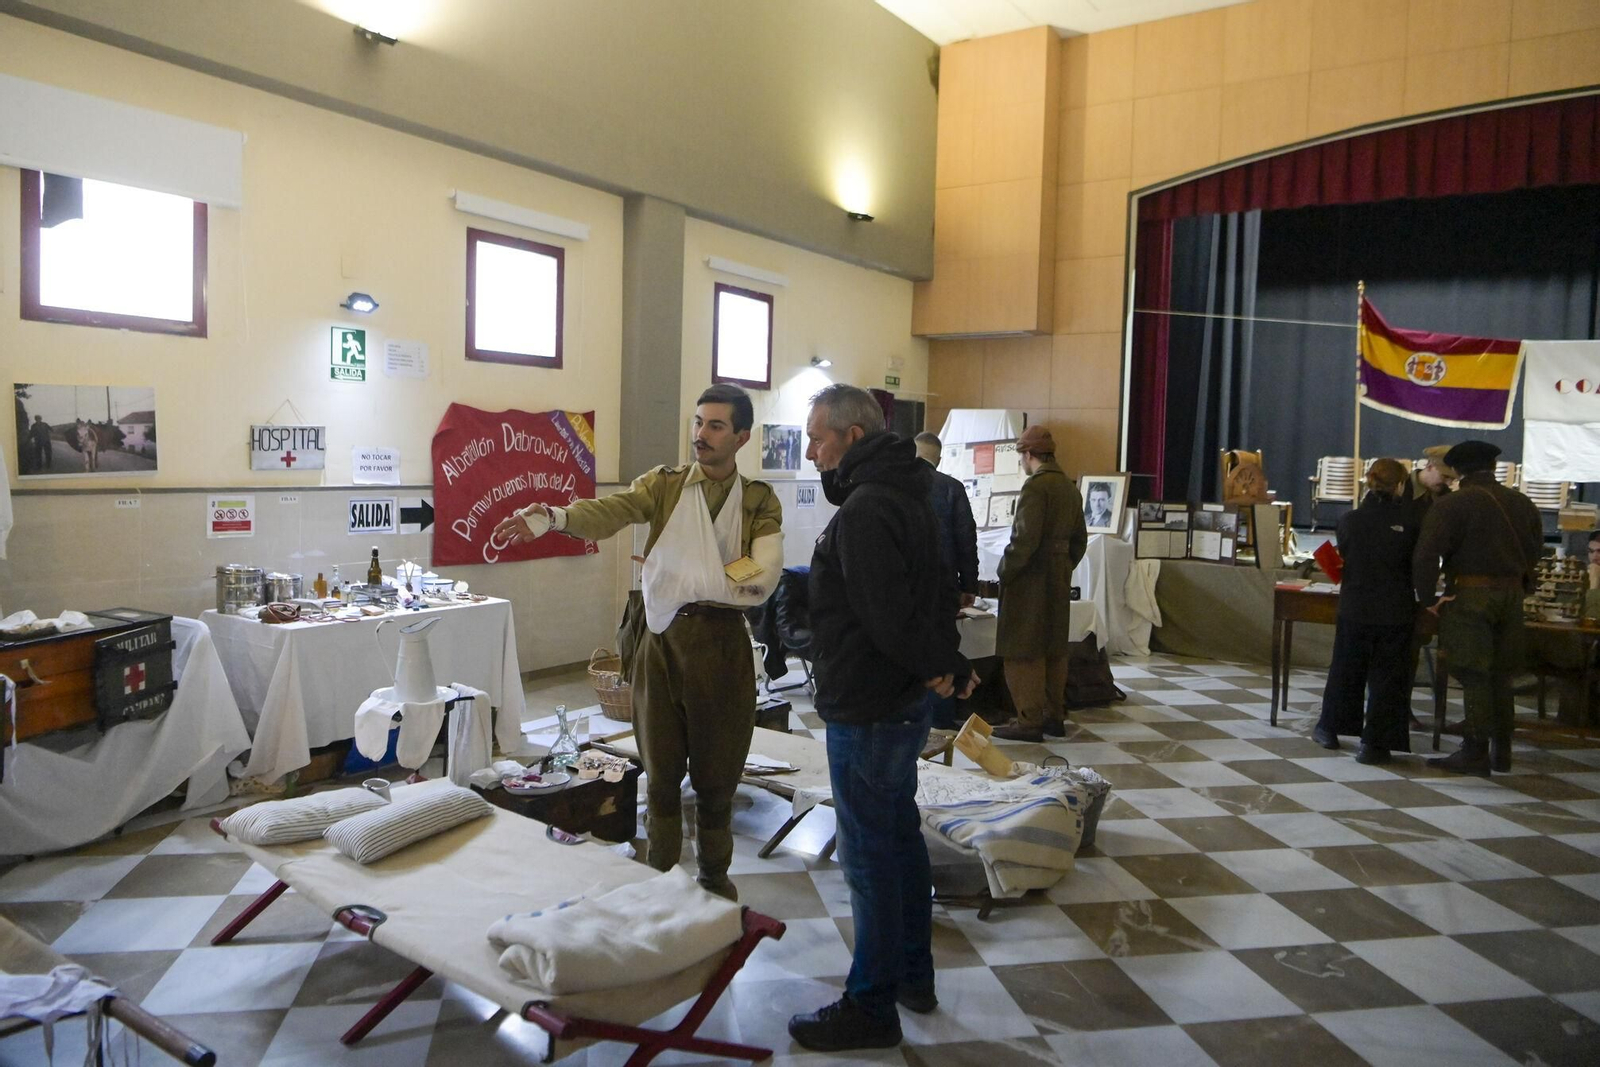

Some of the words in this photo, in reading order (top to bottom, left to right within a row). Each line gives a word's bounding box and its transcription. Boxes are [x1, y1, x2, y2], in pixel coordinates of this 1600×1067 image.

[334, 367, 362, 377] SALIDA
[252, 427, 325, 452] HOSPITAL
[441, 459, 459, 486] Al
[451, 510, 478, 541] Por
[473, 490, 493, 516] muy
[527, 471, 549, 491] hijos
[549, 472, 564, 490] del
[798, 488, 815, 504] SALIDA
[351, 503, 391, 528] SALIDA
